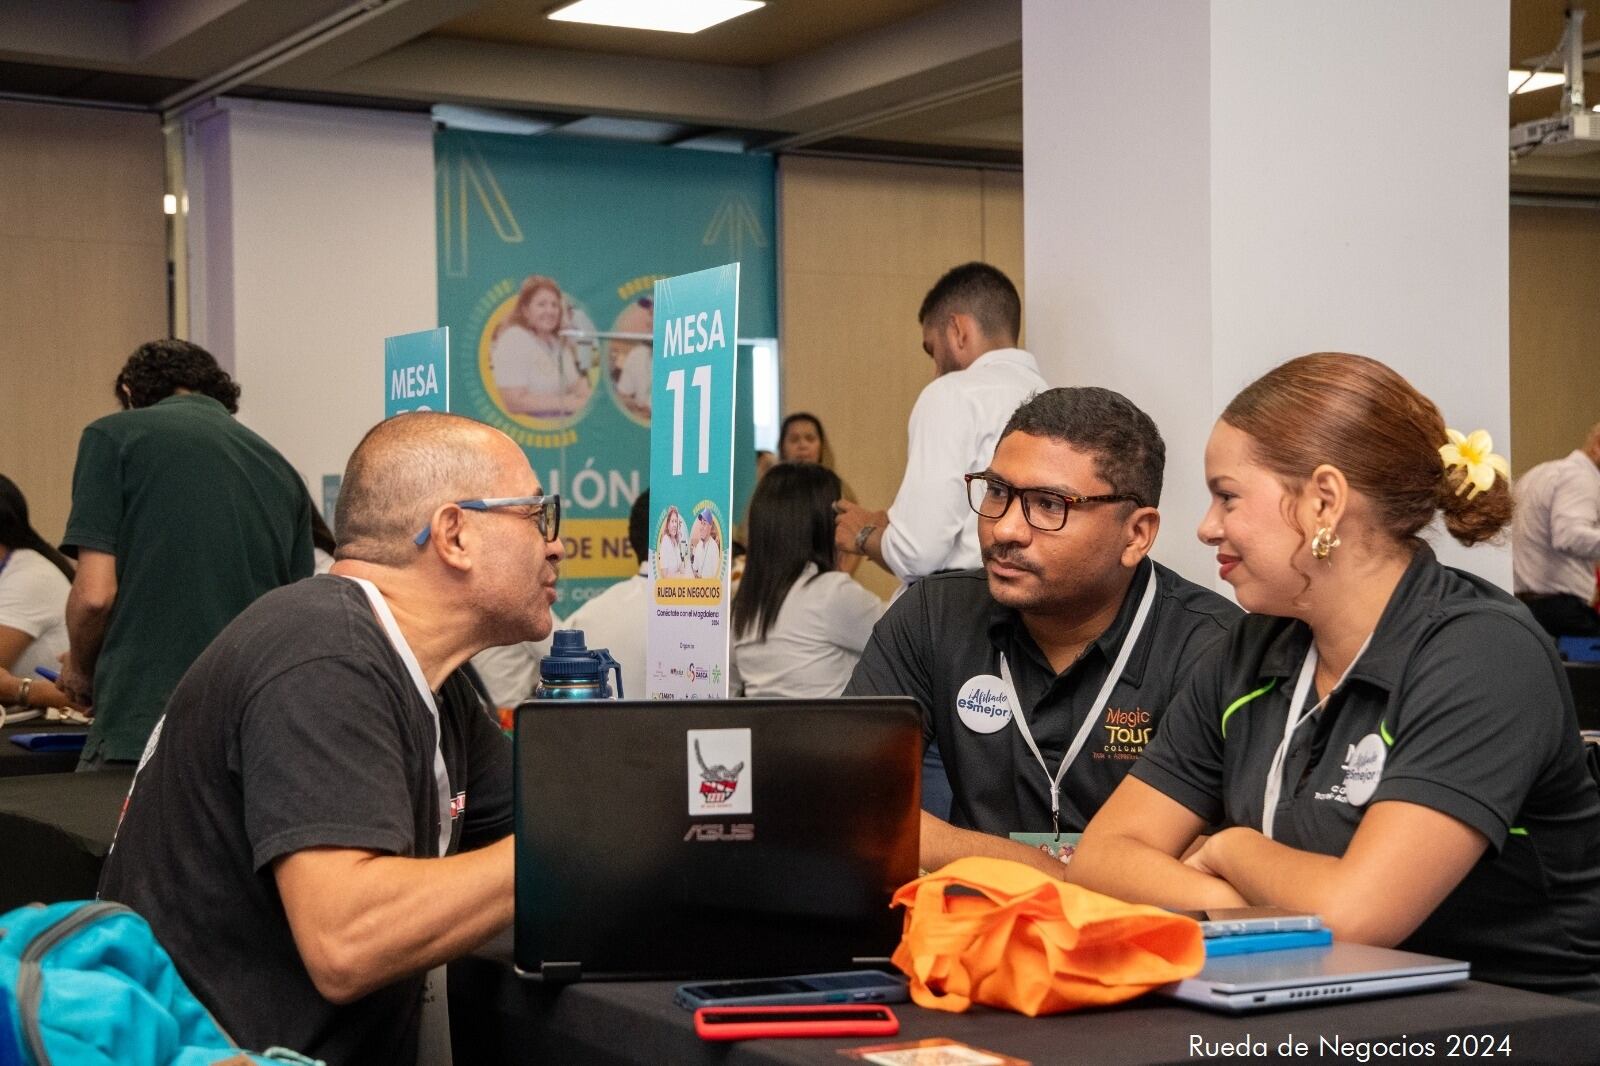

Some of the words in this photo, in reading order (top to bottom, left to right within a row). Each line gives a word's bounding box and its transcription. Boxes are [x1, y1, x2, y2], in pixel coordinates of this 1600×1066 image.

[663, 309, 726, 358] MESA
[391, 363, 439, 401] MESA
[665, 364, 712, 477] 11
[549, 457, 640, 510] LÓN
[601, 535, 634, 560] NE
[657, 587, 677, 598] RUEDA
[677, 587, 686, 598] DE
[687, 586, 720, 599] NEGOCIOS
[692, 609, 720, 620] Magdalena
[1105, 706, 1151, 728] Magic
[1103, 745, 1143, 754] COLOMB
[683, 823, 755, 841] ASUS
